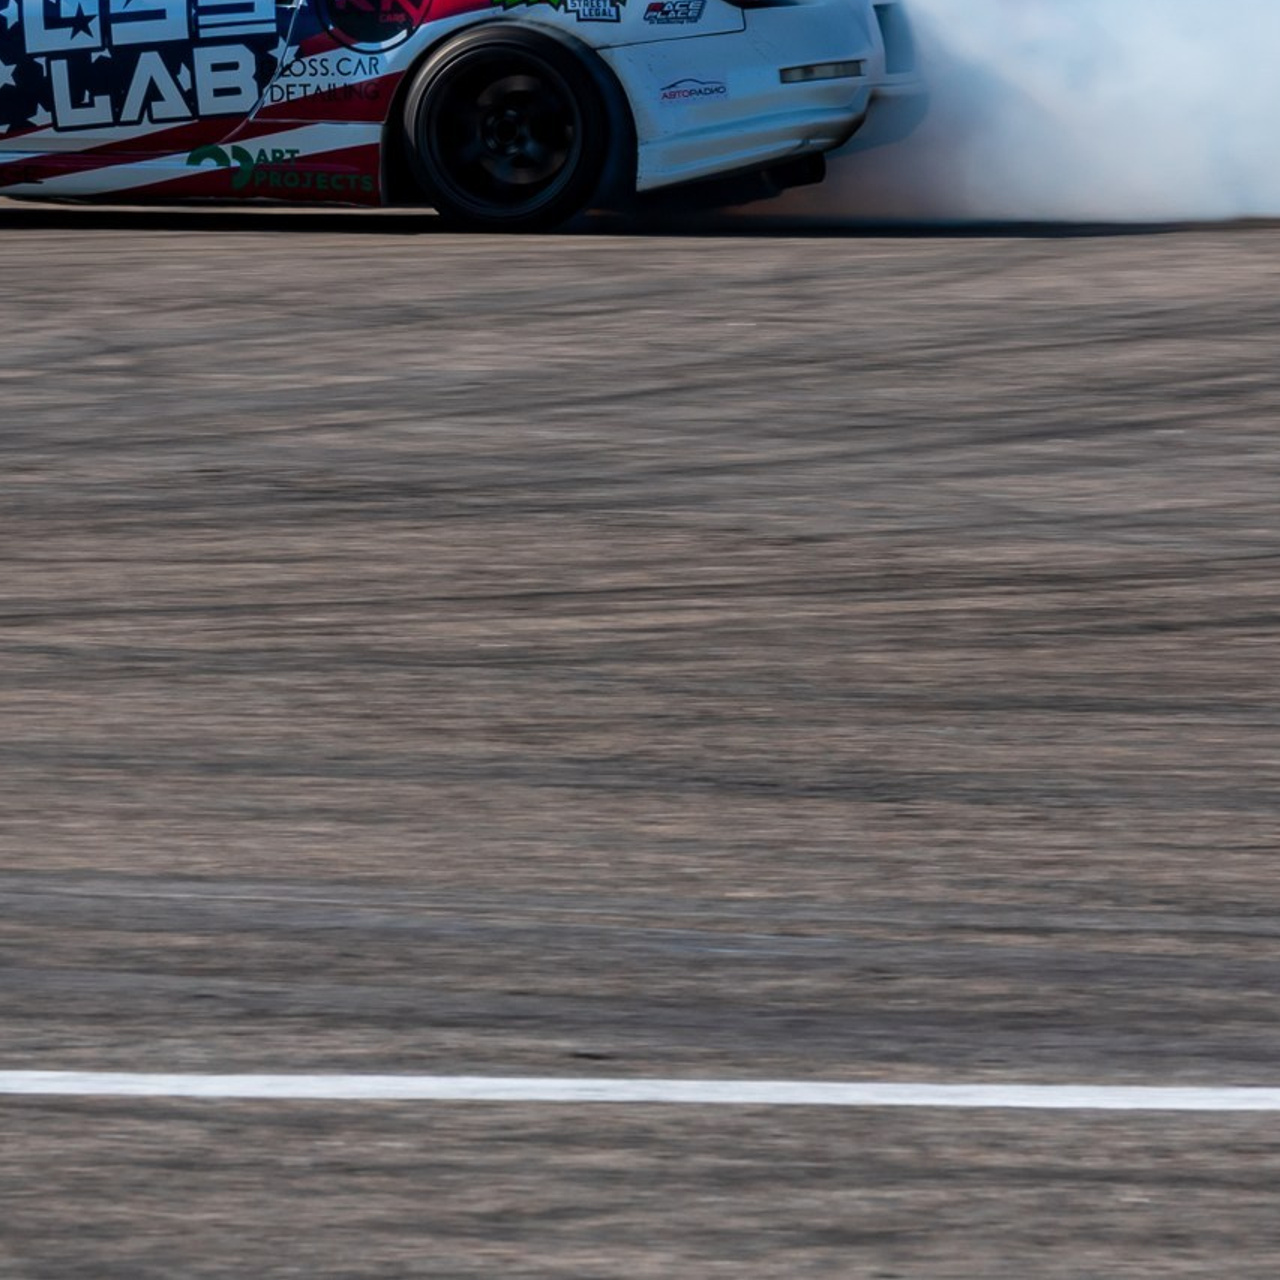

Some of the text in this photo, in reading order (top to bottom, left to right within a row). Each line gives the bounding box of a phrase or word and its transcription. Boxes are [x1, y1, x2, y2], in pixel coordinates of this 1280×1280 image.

[570, 0, 610, 8] STREET
[583, 8, 613, 17] LEGAL
[51, 43, 259, 128] LAB
[270, 83, 380, 102] DETAILING
[256, 148, 300, 165] ART
[254, 170, 374, 192] PROJECTS
